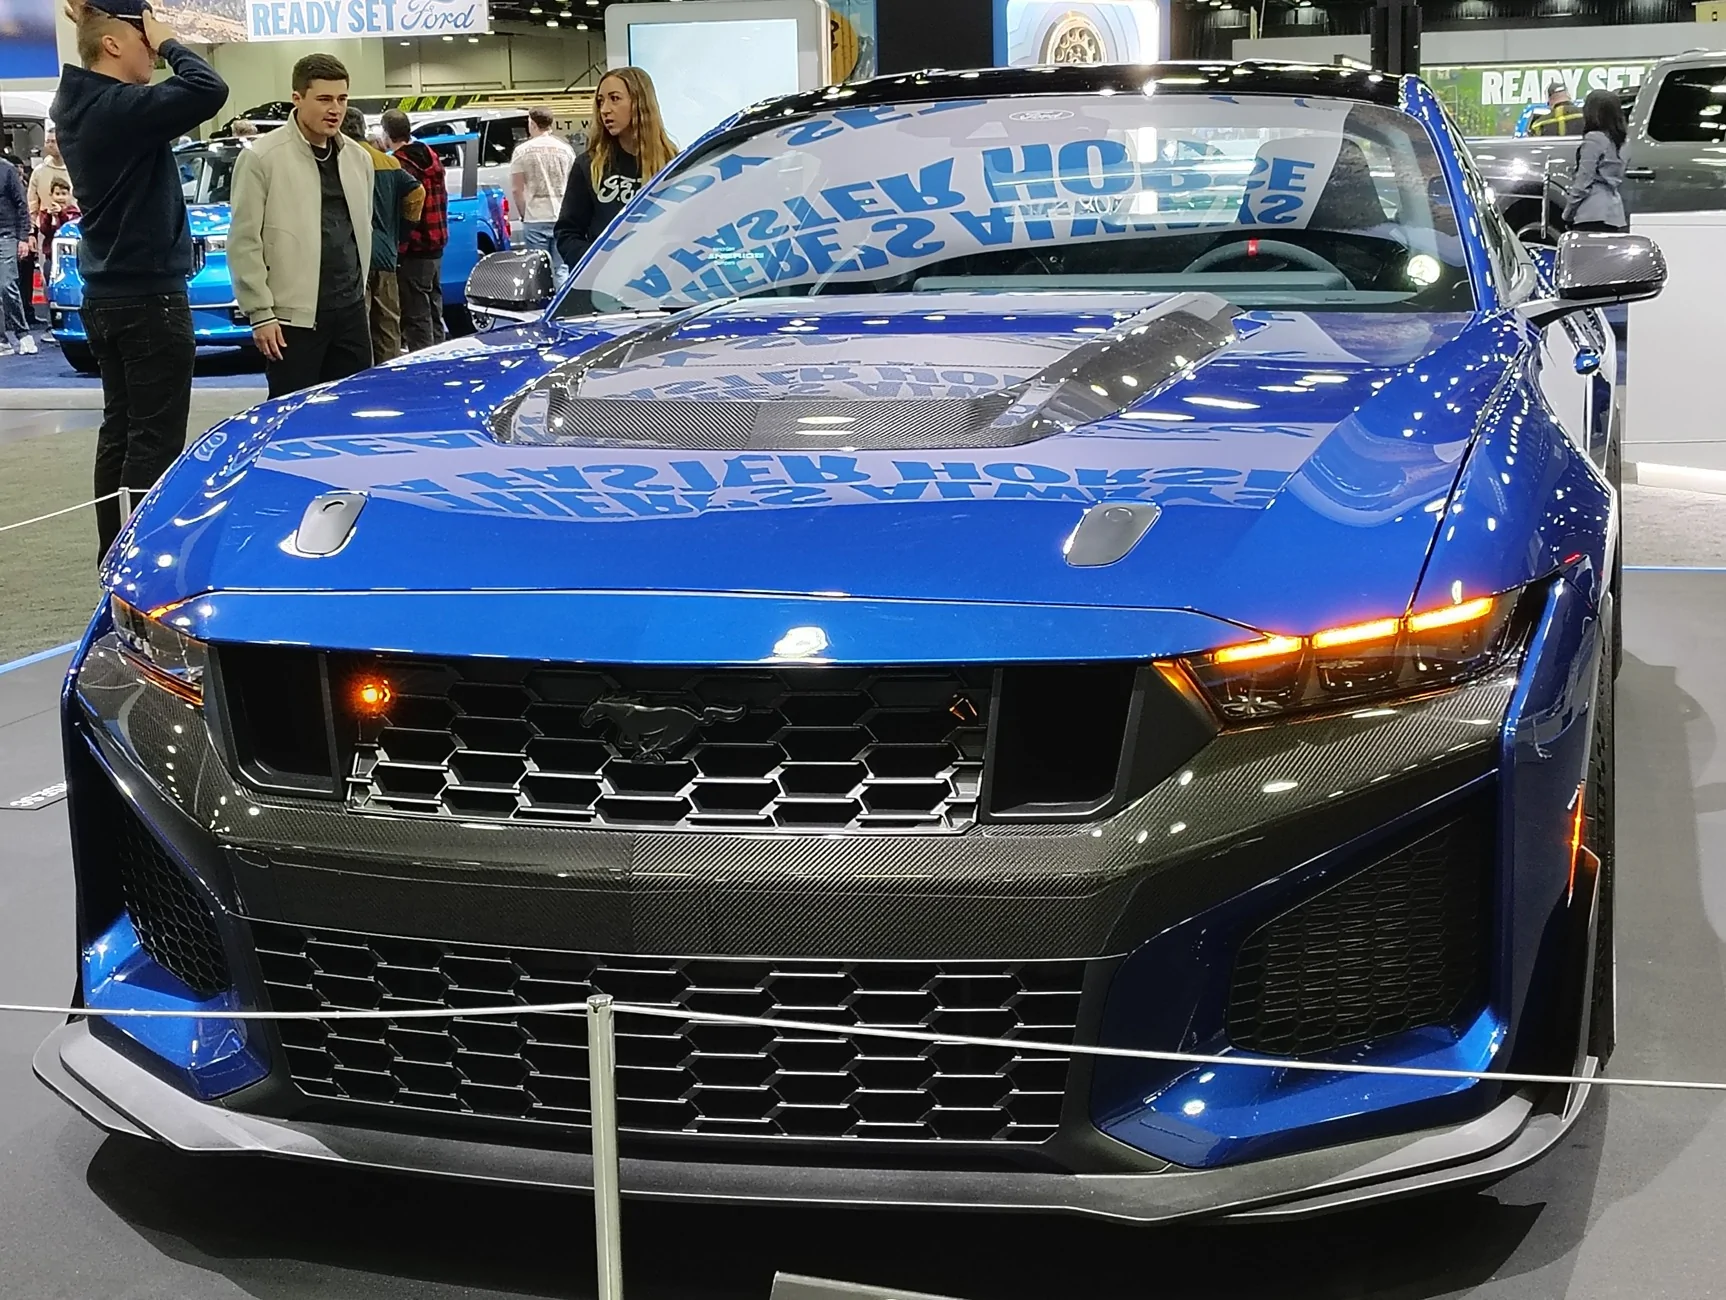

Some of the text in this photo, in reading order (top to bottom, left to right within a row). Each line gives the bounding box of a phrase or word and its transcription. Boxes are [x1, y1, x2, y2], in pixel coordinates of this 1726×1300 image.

[252, 0, 475, 36] READY SET Ford
